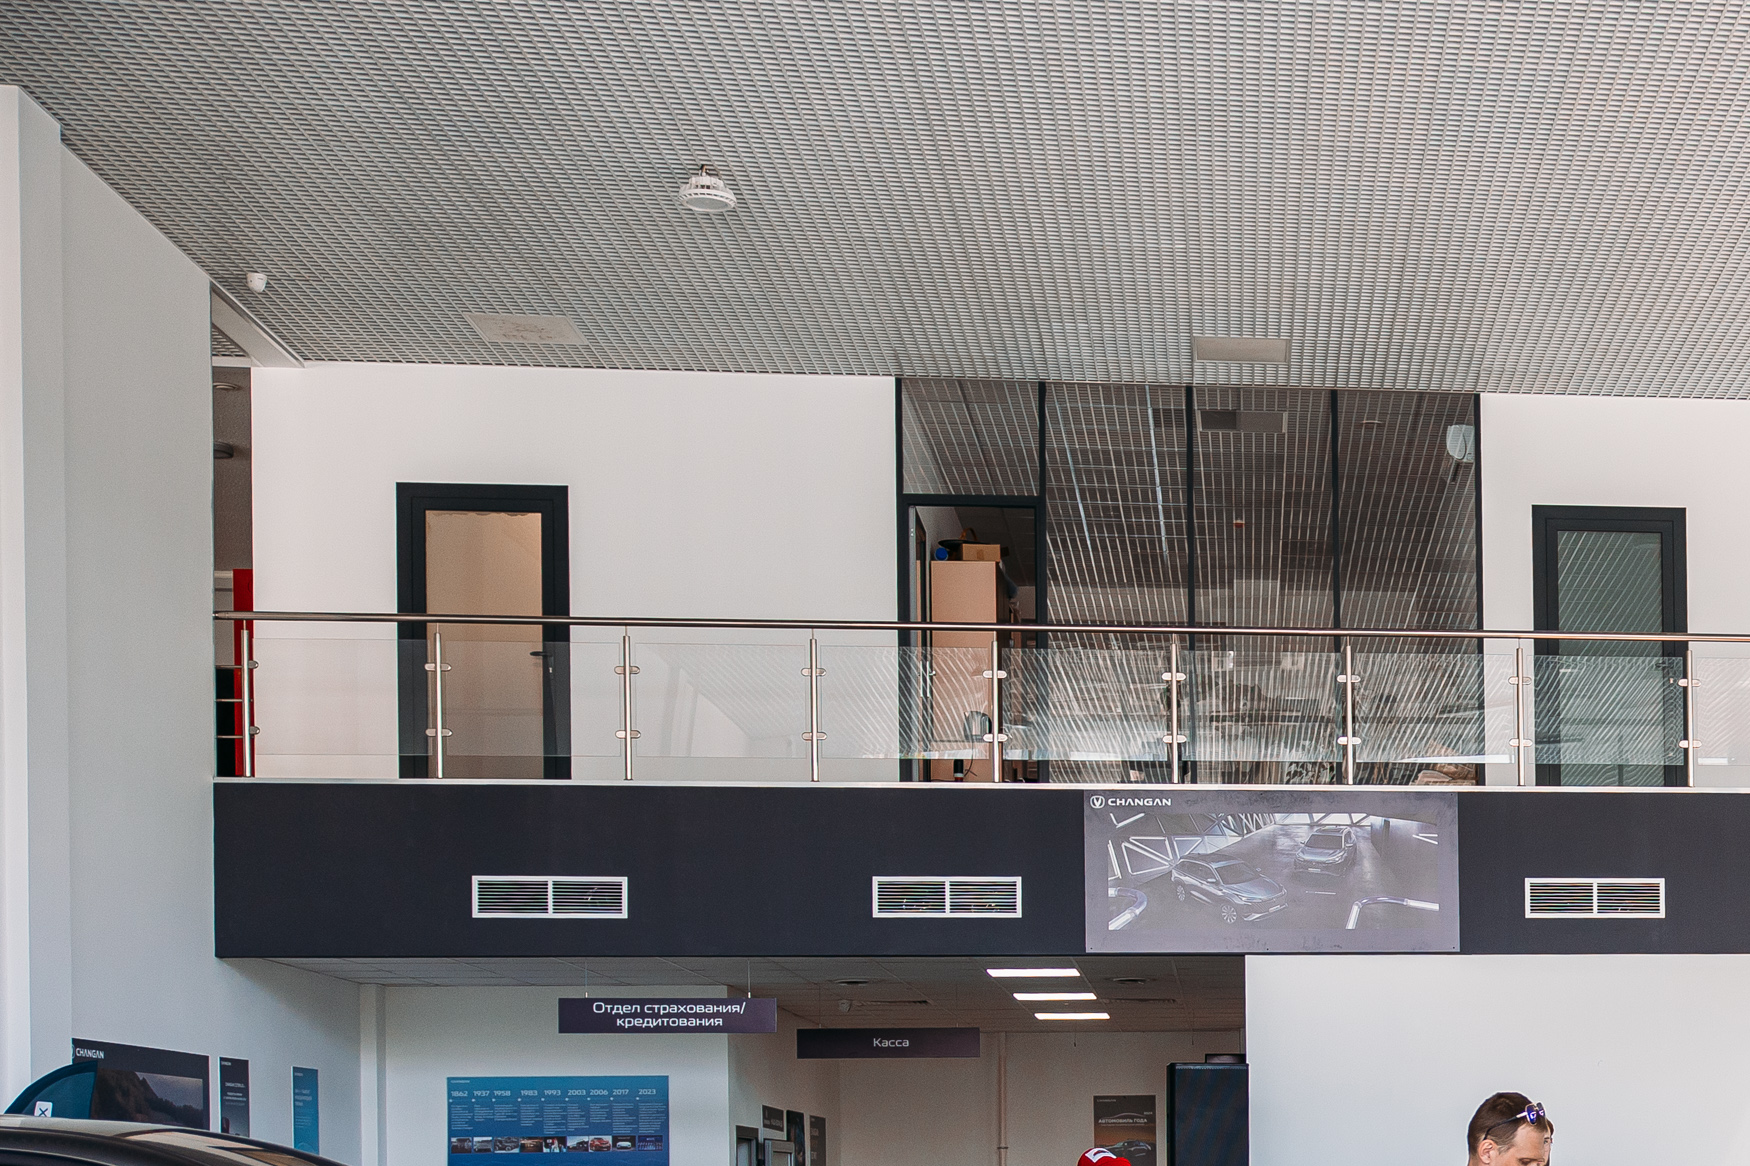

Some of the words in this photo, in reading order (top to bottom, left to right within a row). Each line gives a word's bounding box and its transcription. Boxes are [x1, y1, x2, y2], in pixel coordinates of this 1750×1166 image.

[1107, 798, 1171, 806] CHANGAN
[593, 1002, 640, 1015] Отдел
[644, 1001, 746, 1016] страхования/
[616, 1016, 723, 1029] кредитования
[873, 1037, 909, 1047] Касса
[75, 1047, 105, 1060] CHANGAN
[612, 1088, 629, 1096] 2017
